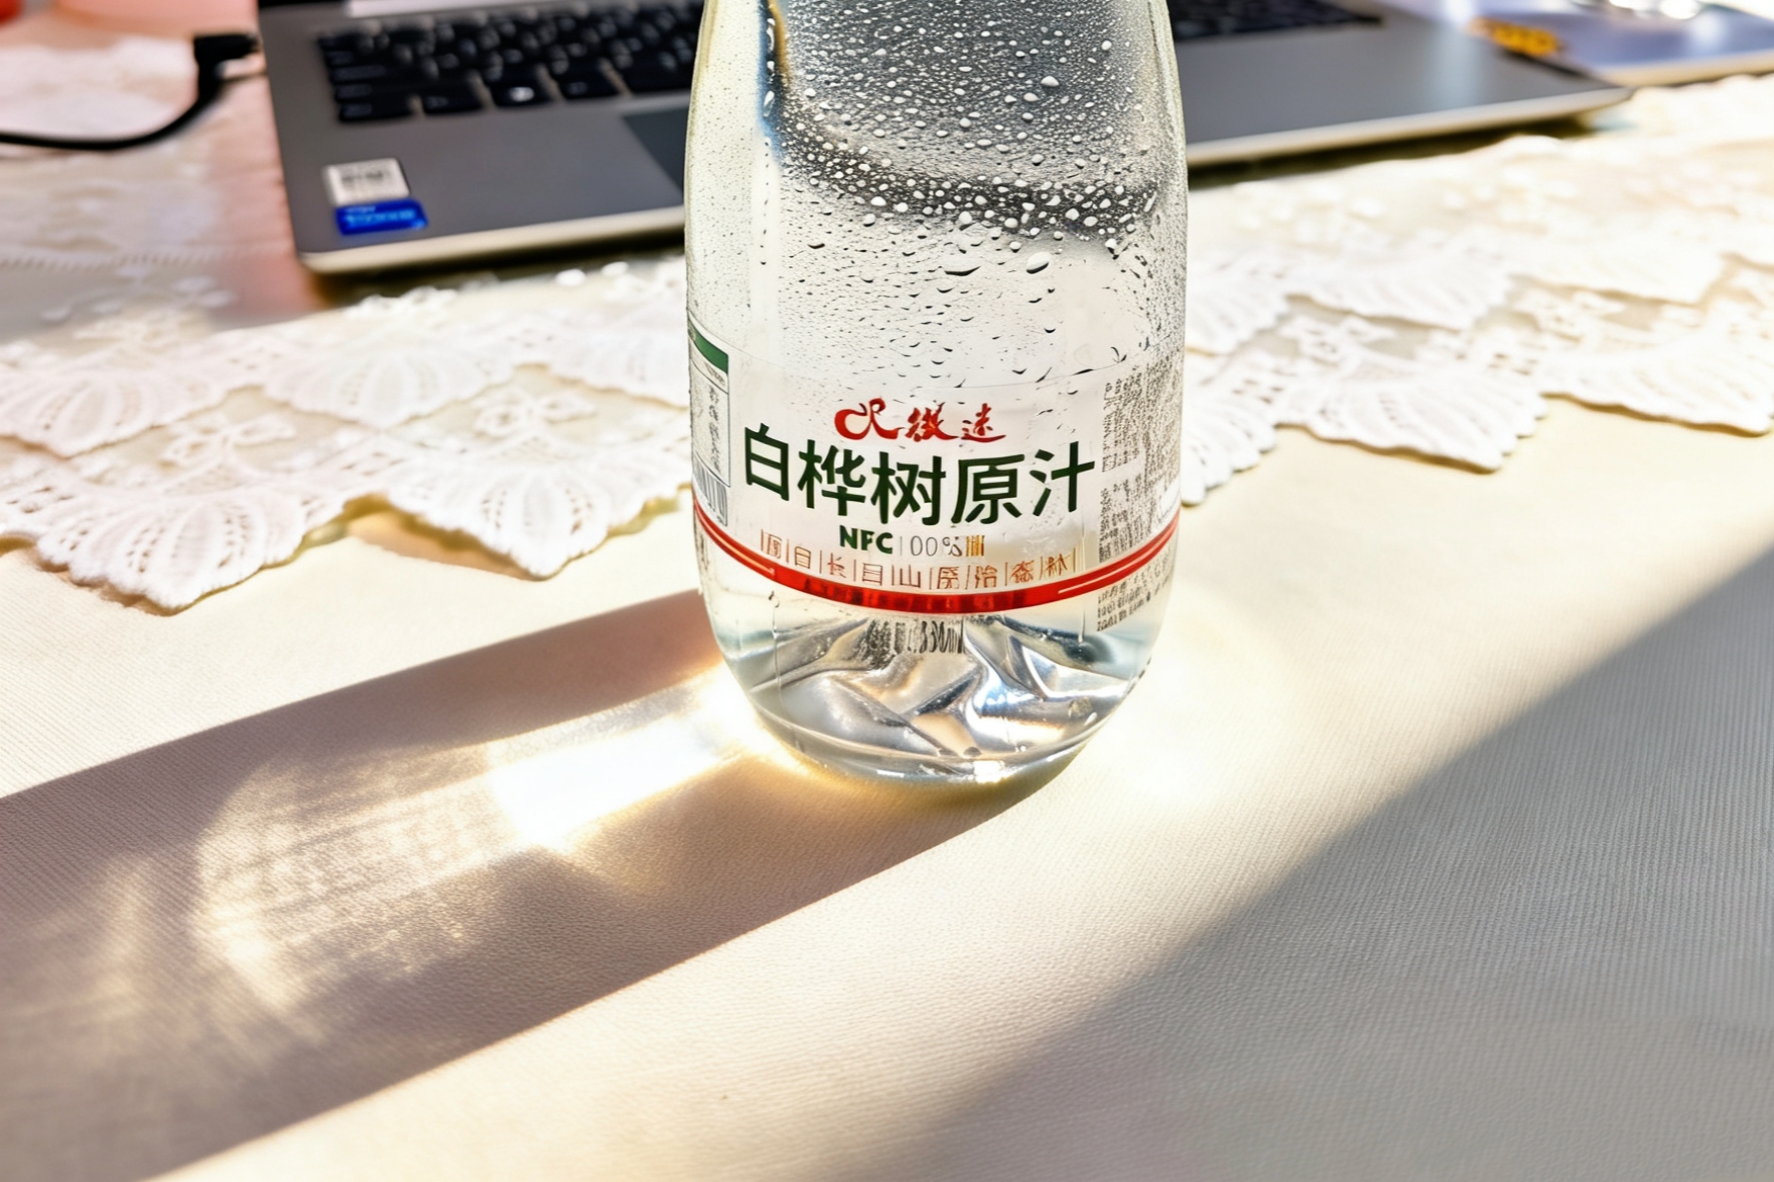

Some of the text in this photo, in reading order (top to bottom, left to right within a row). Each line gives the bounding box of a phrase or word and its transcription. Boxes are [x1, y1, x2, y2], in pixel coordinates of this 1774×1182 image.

[744, 422, 1096, 526] 白桦树原汁
[839, 524, 894, 555] NFC
